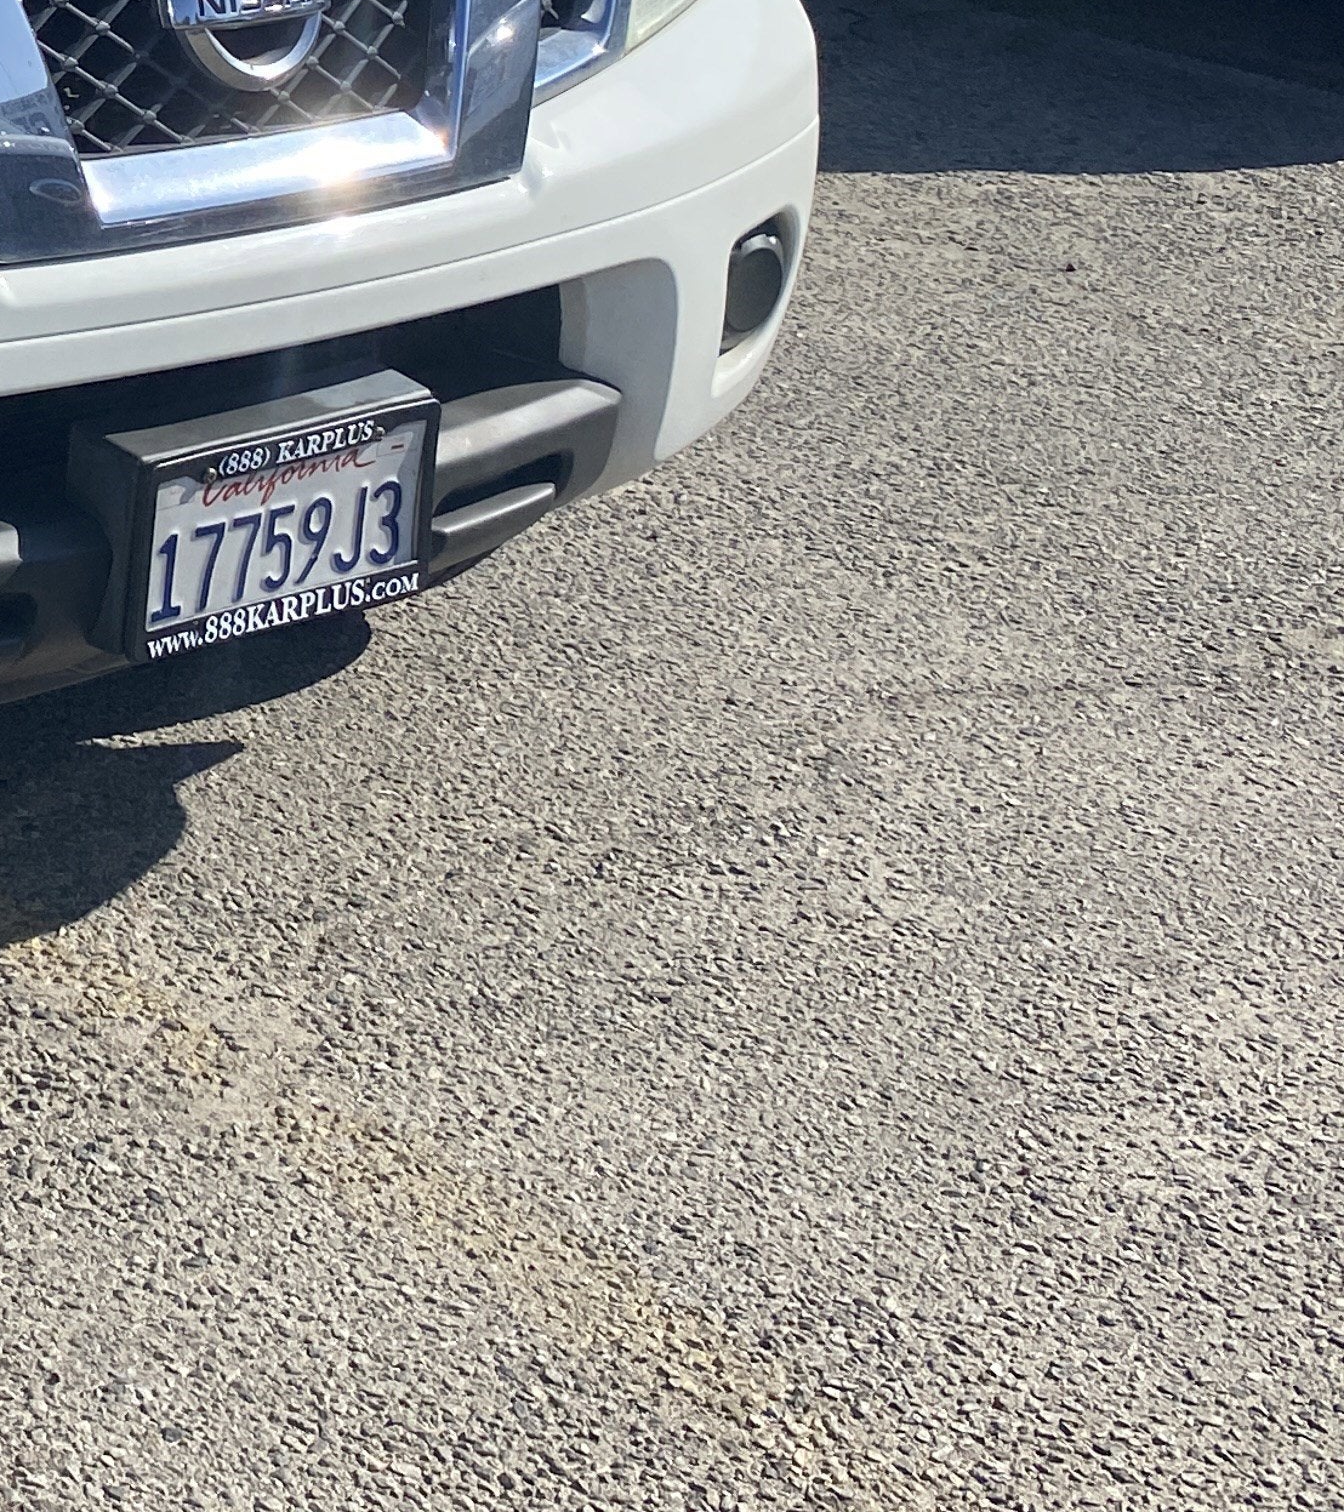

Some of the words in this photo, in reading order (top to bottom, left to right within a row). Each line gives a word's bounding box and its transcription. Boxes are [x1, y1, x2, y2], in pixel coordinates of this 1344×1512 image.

[218, 446, 271, 477] (888)
[275, 419, 375, 465] KARPLUS
[150, 480, 404, 624] 17759J3
